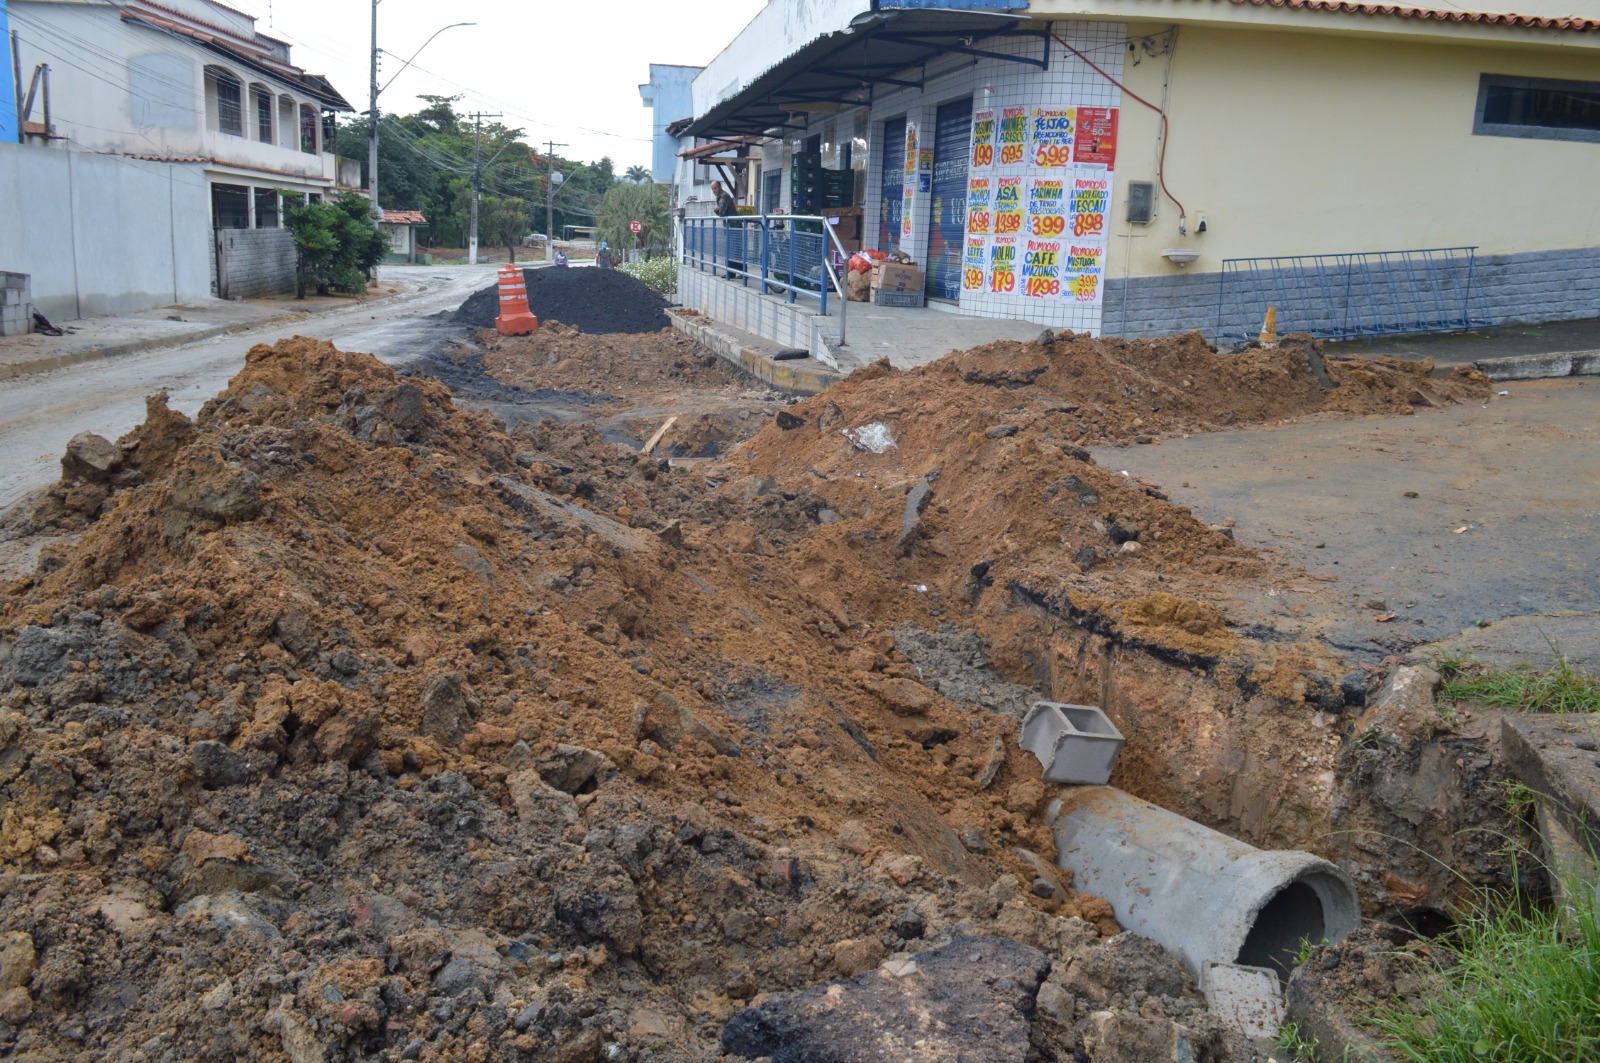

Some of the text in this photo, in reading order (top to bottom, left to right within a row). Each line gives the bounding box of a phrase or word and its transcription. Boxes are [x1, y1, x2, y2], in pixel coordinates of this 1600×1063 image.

[998, 131, 1028, 143] ARISCO
[996, 186, 1018, 200] ASA
[1030, 188, 1063, 200] FARINHA
[1070, 200, 1106, 213] NESCAU
[1032, 216, 1065, 236] 3,99
[968, 247, 984, 257] LEITE
[991, 246, 1016, 260] MOLHO
[1022, 264, 1059, 278] AMAZONAS
